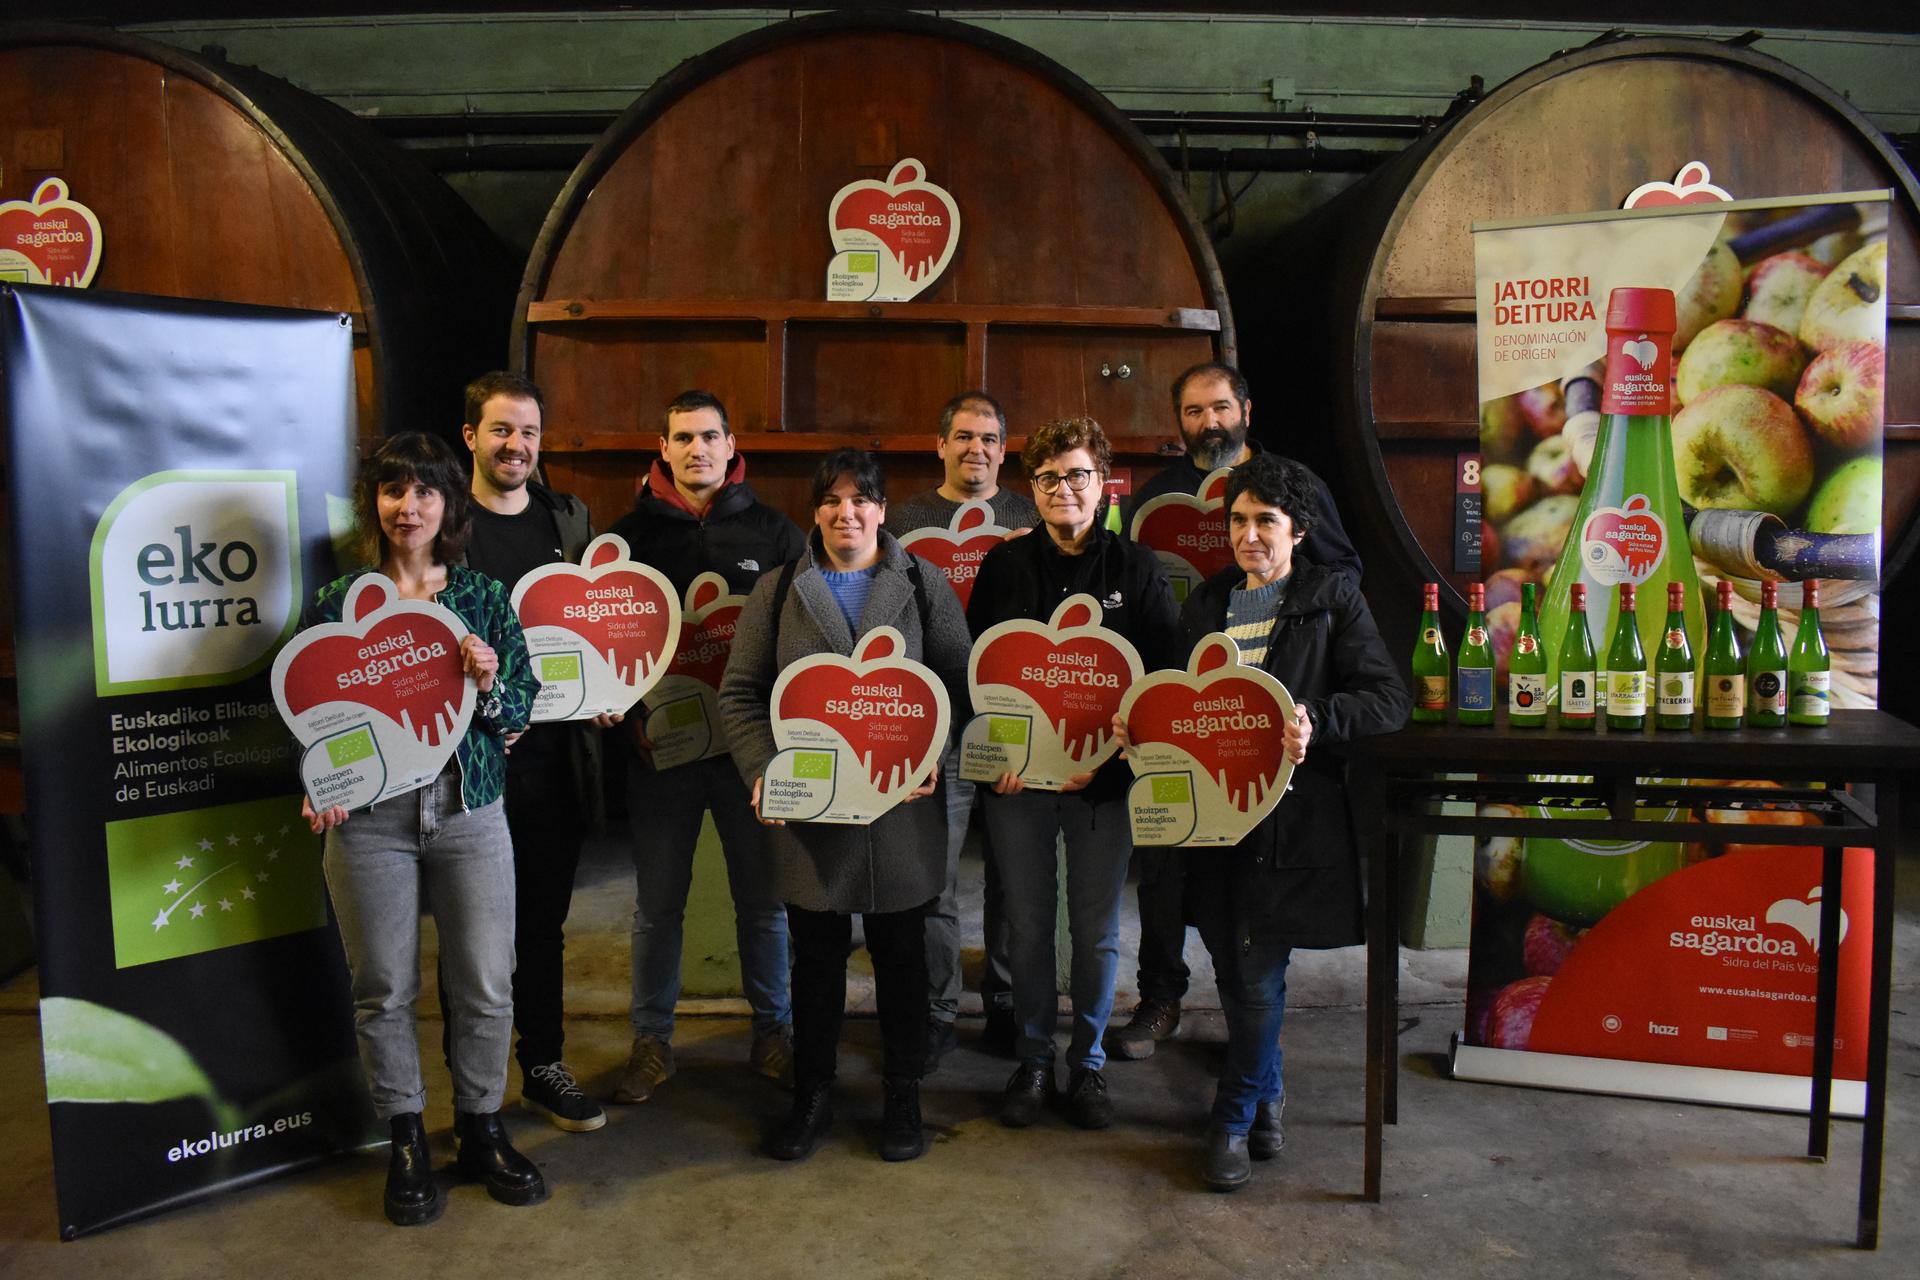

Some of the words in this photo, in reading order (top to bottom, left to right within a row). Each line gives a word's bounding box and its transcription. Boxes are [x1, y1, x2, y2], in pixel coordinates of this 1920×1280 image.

[887, 201, 925, 212] euskal
[33, 219, 68, 231] euskal
[868, 212, 942, 229] sagardoa
[16, 230, 85, 248] sagardoa
[1493, 276, 1590, 306] JATORRI
[1495, 300, 1597, 326] DEITURA
[1494, 329, 1586, 347] DENOMINACIÓN
[1494, 350, 1508, 362] DE
[1512, 348, 1556, 361] ORIGEN
[1624, 373, 1654, 382] euskal
[1612, 382, 1664, 395] sagardoa
[1463, 460, 1480, 485] 8
[1198, 519, 1226, 532] eus
[1177, 533, 1232, 552] sagar
[1605, 531, 1657, 542] sagardoa
[137, 525, 258, 587] eko
[952, 550, 988, 562] eusk
[942, 564, 981, 583] agar
[585, 586, 634, 601] euskal
[139, 591, 261, 632] lurra
[563, 600, 657, 623] sagardoa
[607, 622, 626, 630] Sidra
[627, 621, 639, 629] del
[624, 630, 646, 638] Vasco
[357, 629, 415, 660] euskal
[677, 639, 732, 665] sagar
[336, 640, 447, 690] sagardoa
[1047, 652, 1098, 667] euskal
[392, 674, 414, 689] Sidra
[415, 669, 429, 682] del
[1021, 665, 1119, 688] sagardoa
[395, 685, 413, 699] País
[414, 678, 440, 692] Vasco
[851, 683, 902, 699] euskal
[1063, 690, 1083, 700] Sidra
[1084, 692, 1096, 702] del
[1063, 700, 1079, 710] País
[1080, 702, 1103, 712] Vasco
[1193, 695, 1245, 712] euskal
[1464, 694, 1484, 704] 1565
[111, 708, 210, 732] Euskadiko
[215, 701, 277, 721] Elikaga
[825, 698, 925, 720] sagardoa
[868, 722, 888, 731] Sidra
[890, 723, 902, 732] del
[1171, 711, 1271, 738] sagardoa
[113, 725, 231, 755] Ekologikoak
[868, 732, 885, 741] País
[886, 733, 909, 742] Vasco
[1217, 738, 1237, 748] Sidra
[1238, 737, 1251, 746] del
[1218, 749, 1235, 758] País
[1236, 747, 1260, 756] Vasco
[114, 755, 208, 780] Alimentos
[214, 746, 286, 767] Ecológic
[312, 768, 353, 787] Ekoizpen
[316, 775, 365, 797] ekologikoa
[770, 779, 807, 789] Ekoizpen
[115, 785, 140, 803] de
[145, 773, 215, 799] Euskadi
[769, 788, 813, 799] ekologikoa
[1135, 806, 1168, 815] Ekoizpen
[1135, 816, 1177, 824] ekologikoa
[1691, 915, 1756, 932] euskal
[1670, 930, 1798, 956] sagardoa
[1722, 956, 1750, 968] Sidra
[1753, 958, 1769, 969] del
[1772, 960, 1795, 972] País
[1797, 962, 1817, 974] Vas
[1699, 985, 1816, 1003] www.euskalsagardoa.e
[1648, 1021, 1679, 1036] hazi
[167, 1111, 313, 1162] ekolurra.eus
